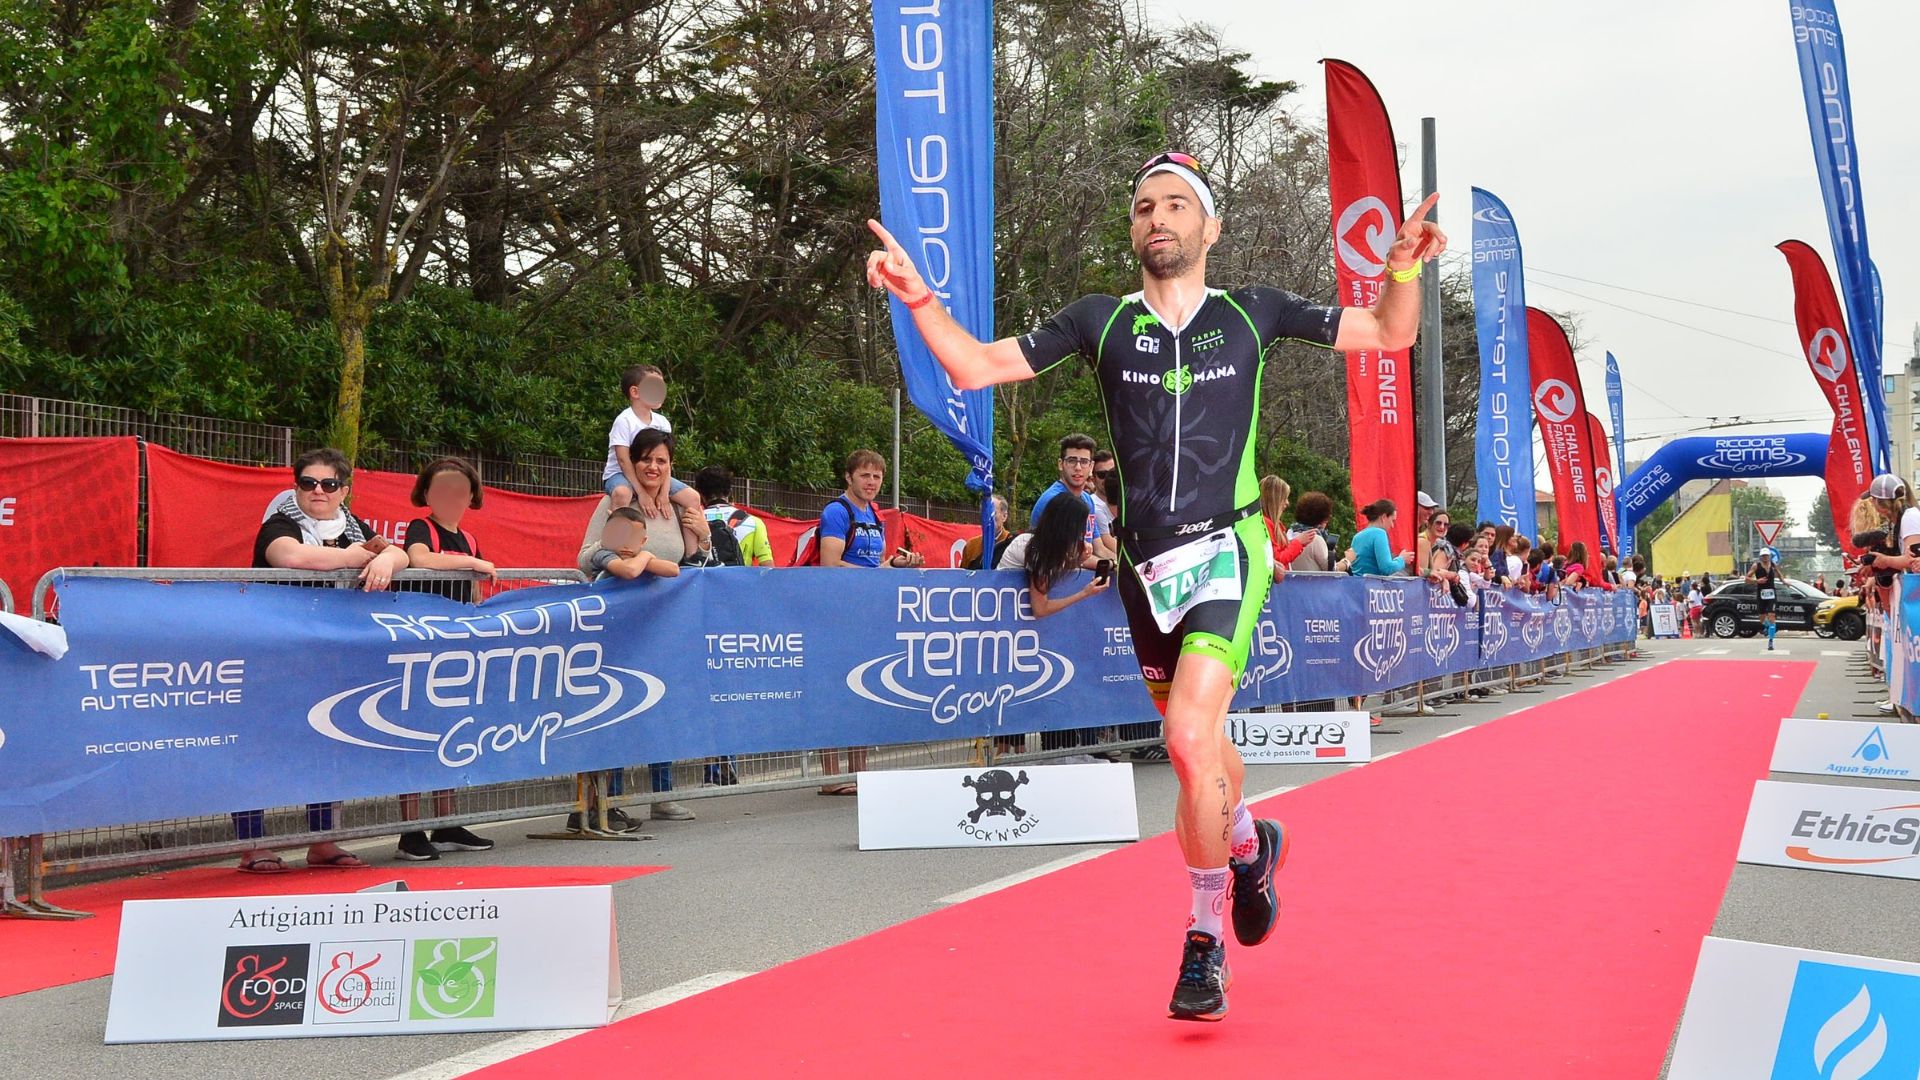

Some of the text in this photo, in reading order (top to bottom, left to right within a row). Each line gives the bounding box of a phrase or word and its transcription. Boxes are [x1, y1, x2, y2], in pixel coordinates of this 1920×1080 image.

[1191, 328, 1223, 343] PARMA
[1193, 338, 1225, 353] ITALIA
[1122, 364, 1237, 385] KINO MANA
[1553, 424, 1568, 462] FAMILY
[1835, 383, 1863, 485] CHALLENGE
[1563, 424, 1587, 503] CHALLENGE
[1160, 562, 1210, 607] 746
[1305, 619, 1340, 633] TERME
[705, 633, 803, 653] TERME
[1103, 645, 1136, 656] AUTEN
[707, 655, 803, 670] AUTENTICHE
[79, 660, 245, 690] TERME
[1103, 673, 1143, 682] RICCIONETE
[81, 689, 242, 711] AUTENTICHE
[931, 683, 1016, 725] Group
[86, 734, 238, 755] RICCIONETERME.IT
[437, 712, 563, 767] Group
[1273, 749, 1311, 759] passione
[1825, 763, 1910, 777] Aqua Sphere
[957, 819, 993, 842] ROCK
[1012, 816, 1040, 838] ROLL
[228, 899, 500, 933] Artigiani in Pasticceria
[242, 978, 306, 996] FOOD
[343, 976, 396, 992] Gardini
[274, 1001, 304, 1011] SPACE
